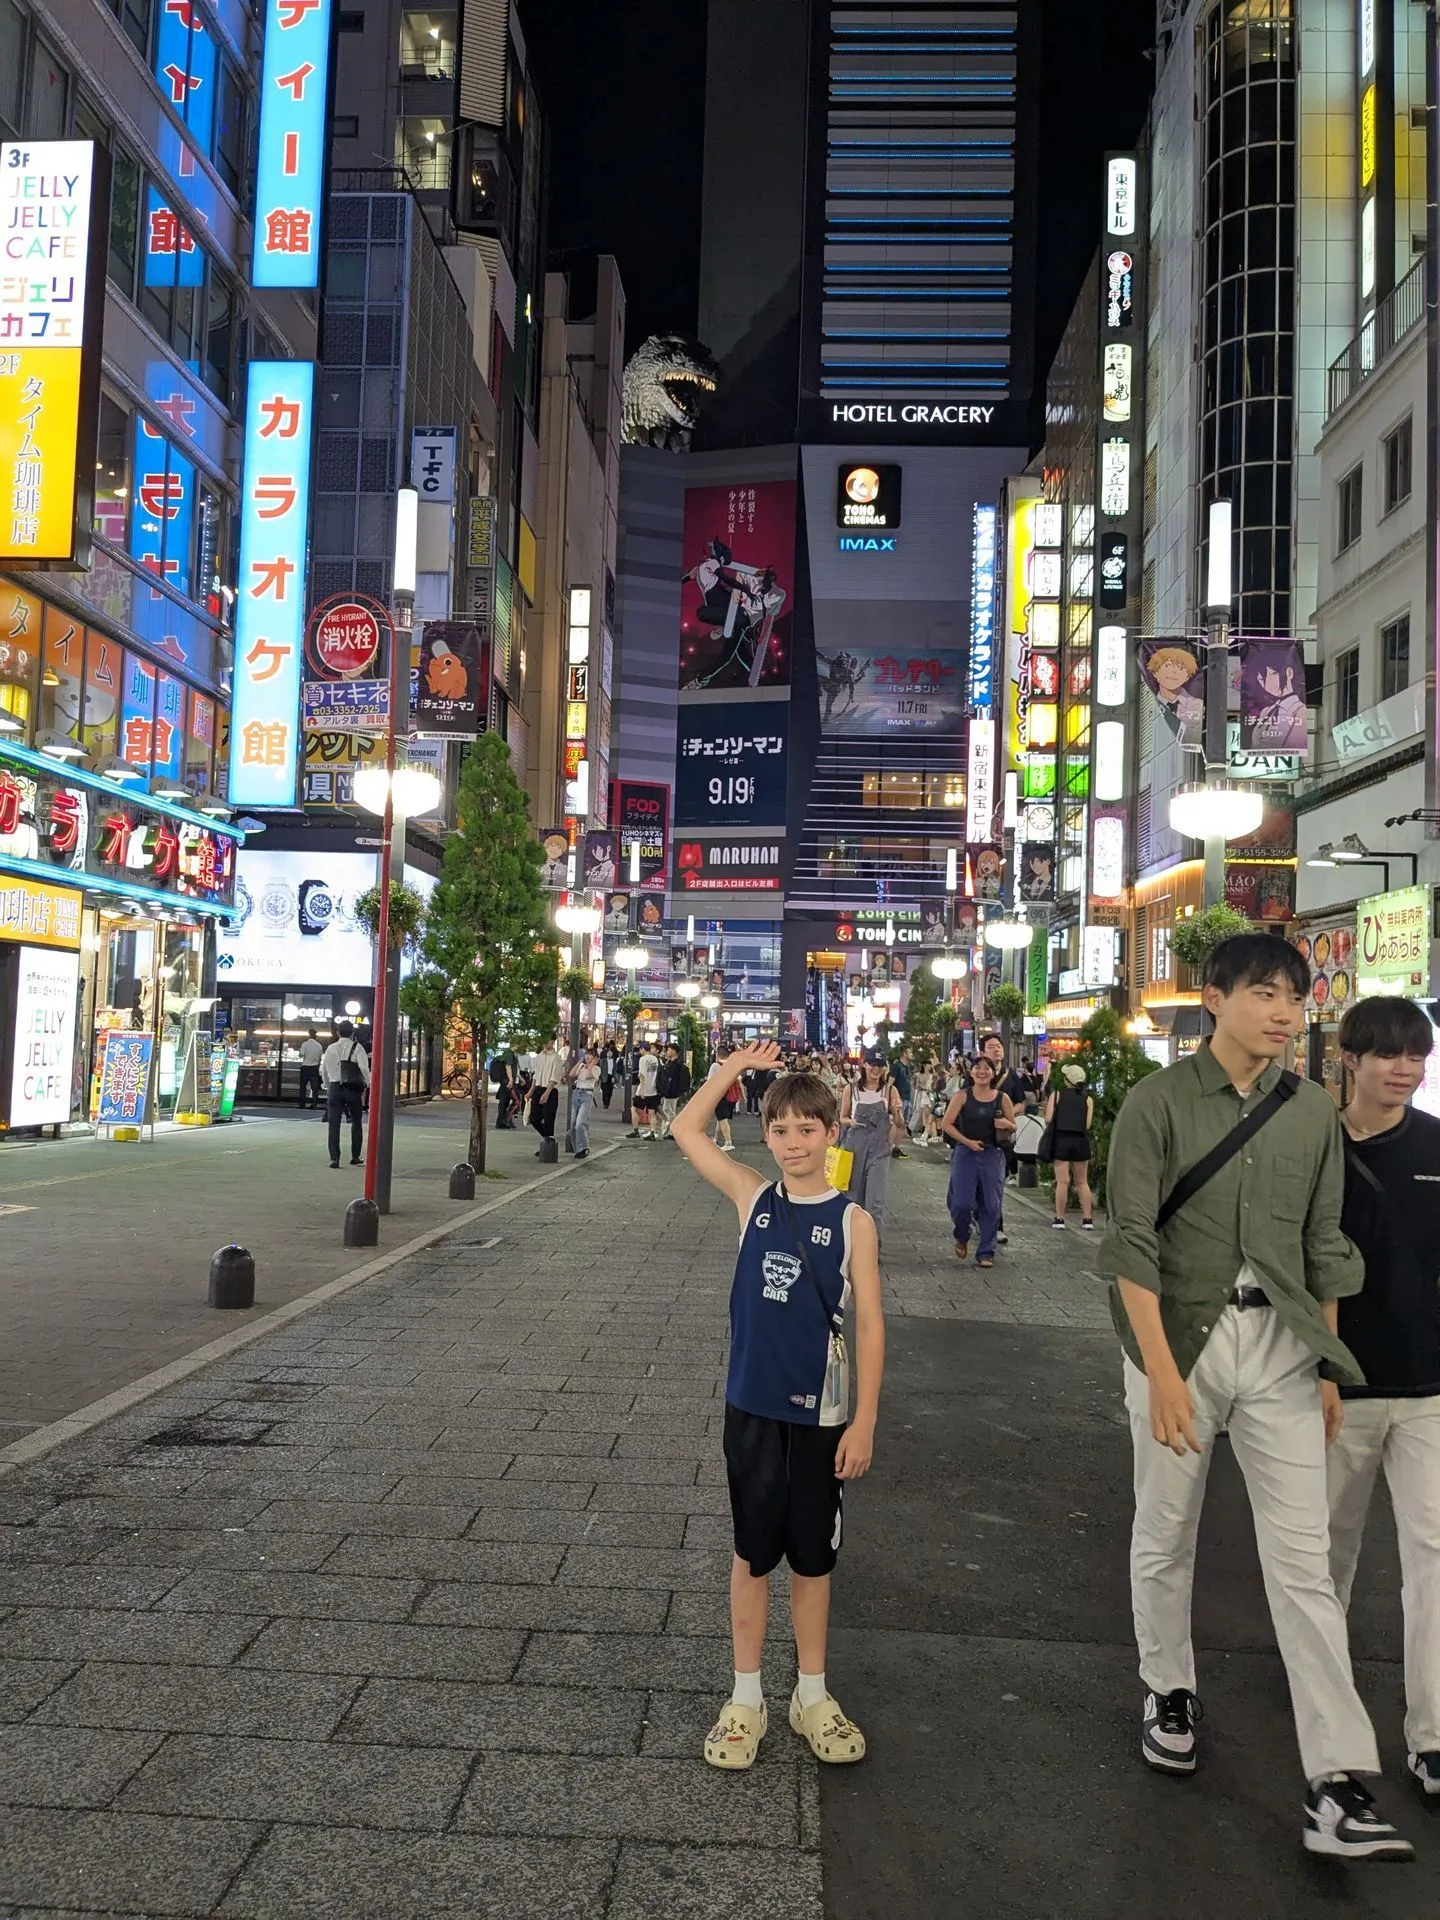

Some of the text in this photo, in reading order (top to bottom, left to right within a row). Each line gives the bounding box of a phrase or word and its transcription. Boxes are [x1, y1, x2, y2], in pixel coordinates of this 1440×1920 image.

[7, 149, 31, 168] 3F
[10, 175, 80, 199] JELLY
[1114, 173, 1129, 229] 東京ビル
[8, 205, 78, 229] JELLY
[6, 236, 77, 260] CAFE
[1, 276, 75, 303] ジェリ
[0, 312, 72, 338] カフェ
[832, 405, 995, 424] HOTEL GRACERY
[10, 376, 43, 546] タイム珈琲店
[844, 504, 876, 516] TOHO
[843, 515, 887, 526] CINEMAS
[839, 537, 895, 551] IMAX
[1111, 545, 1125, 555] 6F
[240, 393, 304, 768] カラオケ館
[327, 612, 367, 623] FIRE HYDRANT
[323, 623, 373, 652] 消火栓
[872, 655, 958, 685] プレデター
[576, 667, 585, 694] ダーツ
[888, 684, 940, 693] バッドランド
[326, 682, 389, 706] セキネ
[319, 704, 381, 716] 03-3352-7325
[422, 700, 475, 711] チェンソーマン
[897, 701, 928, 714] 11.7 FRI
[322, 714, 386, 726] アルタ裏 買取
[887, 719, 911, 727] IMAX
[408, 750, 438, 758] EXCHANGE
[687, 736, 783, 757] チェンソーマン
[708, 777, 750, 805] 9.19
[971, 743, 988, 842] 新宿東宝ビル
[626, 797, 660, 813] FOD
[709, 847, 780, 865] MARUHAN
[54, 899, 79, 918] TIME
[1387, 906, 1423, 926] 無料案内所
[53, 919, 78, 938] CAFE
[237, 957, 284, 968] OKURA
[28, 1008, 65, 1034] JELLY
[25, 1042, 63, 1067] JELLY
[24, 1075, 61, 1101] CAFE
[110, 1054, 128, 1104] できます
[121, 1042, 143, 1118] すぐにご案内
[755, 1212, 771, 1229] G
[810, 1225, 832, 1247] 59
[768, 1253, 798, 1266] GEELONG
[762, 1285, 789, 1303] CATS
